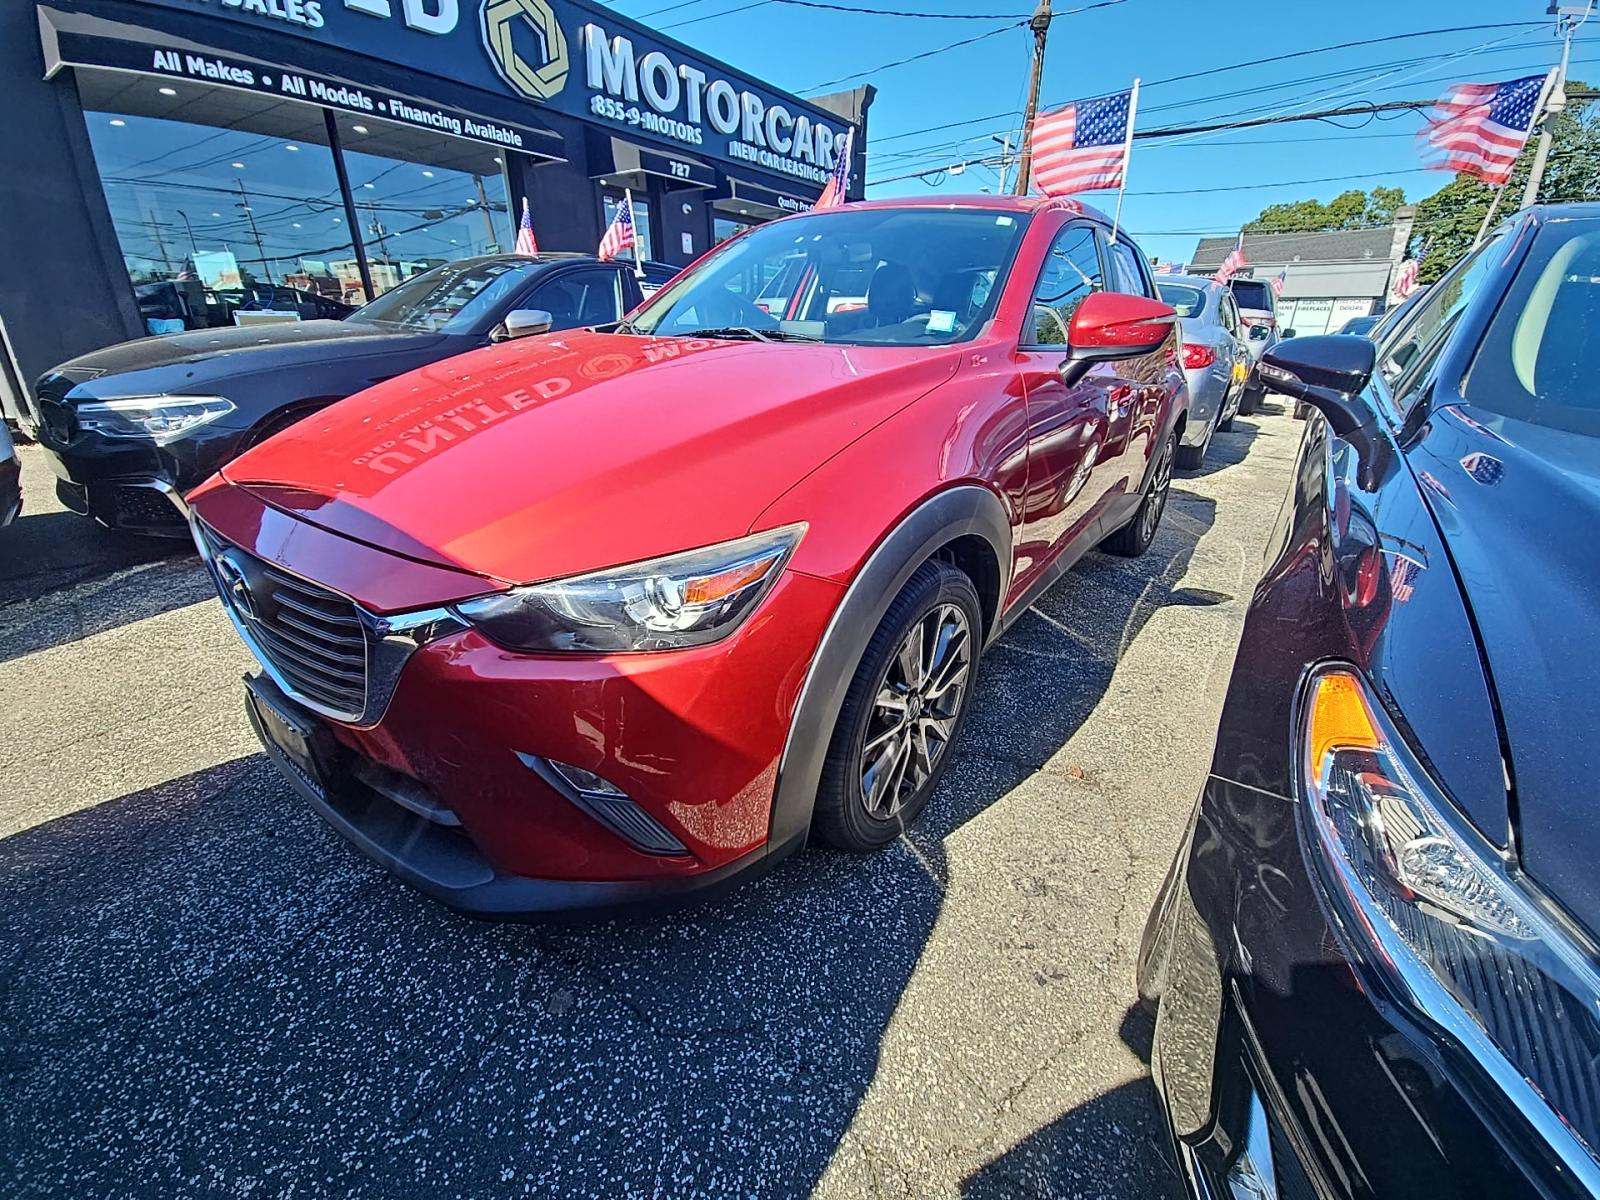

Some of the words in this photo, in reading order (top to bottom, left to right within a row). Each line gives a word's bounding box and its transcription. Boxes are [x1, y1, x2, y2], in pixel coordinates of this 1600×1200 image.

[153, 50, 182, 72] All
[186, 55, 254, 85] Makes
[281, 74, 306, 96] All
[309, 80, 374, 111] Models
[389, 99, 462, 135] Financing
[464, 118, 522, 146] Available
[590, 95, 702, 144] 855-9-MOTORS
[669, 161, 691, 178] 727
[729, 140, 758, 161] NEW
[758, 150, 781, 170] CAR
[780, 157, 819, 180] LEASING
[778, 196, 799, 212] Quality
